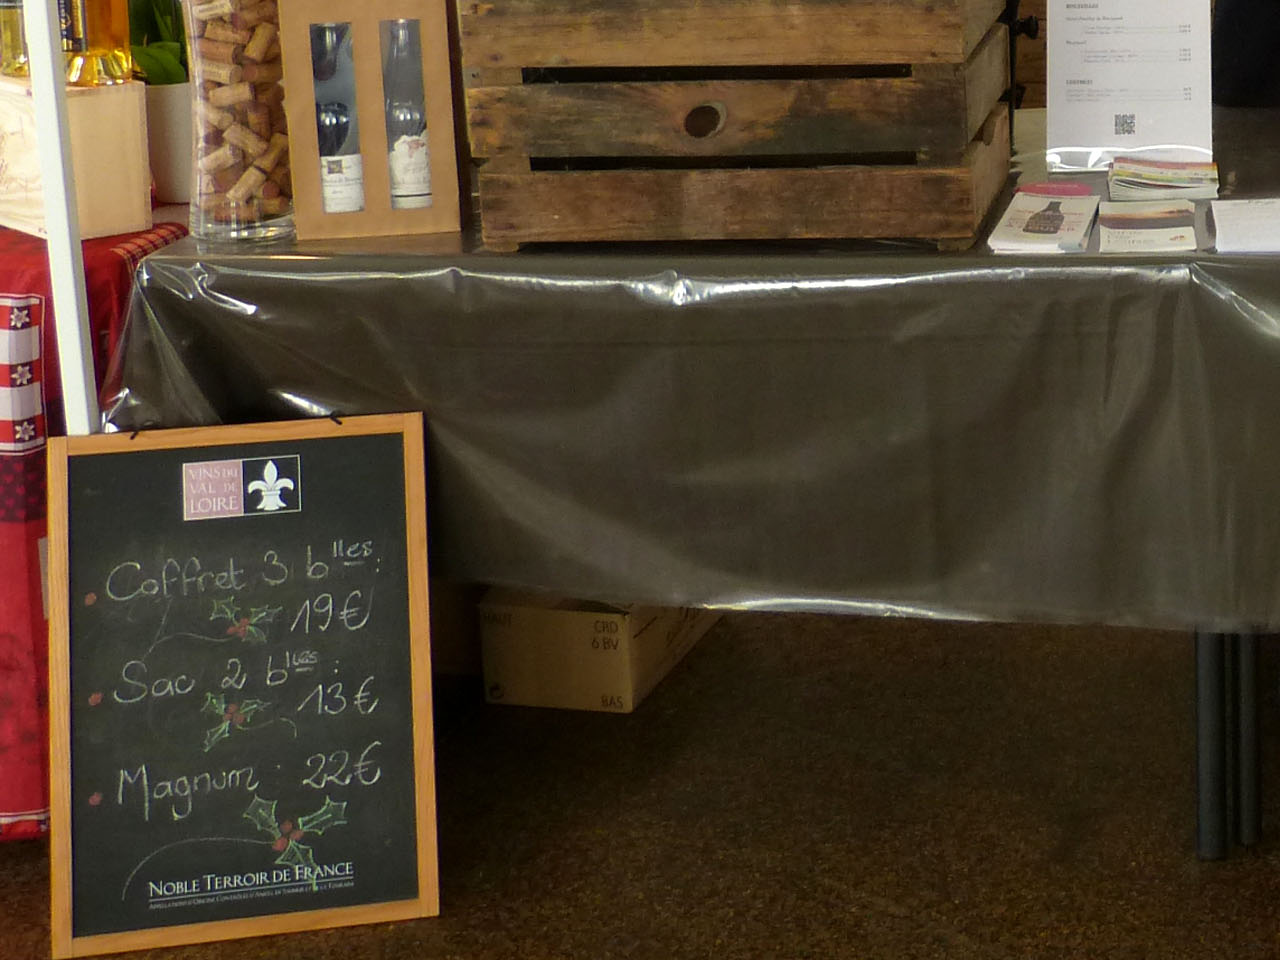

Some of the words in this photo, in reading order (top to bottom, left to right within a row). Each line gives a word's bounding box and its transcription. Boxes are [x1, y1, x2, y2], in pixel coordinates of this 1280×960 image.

[188, 467, 220, 480] VINS
[190, 483, 216, 495] VAL
[190, 496, 239, 514] LOIRE
[106, 559, 244, 602] Coffret
[263, 551, 289, 587] 3
[290, 588, 370, 635] 19€
[113, 659, 196, 704] Sac
[221, 658, 247, 690] 2
[297, 675, 379, 716] 13€
[148, 879, 201, 898] NOBLE
[203, 870, 270, 891] TERROIR
[273, 867, 292, 883] DE
[295, 861, 355, 881] FRANCE
